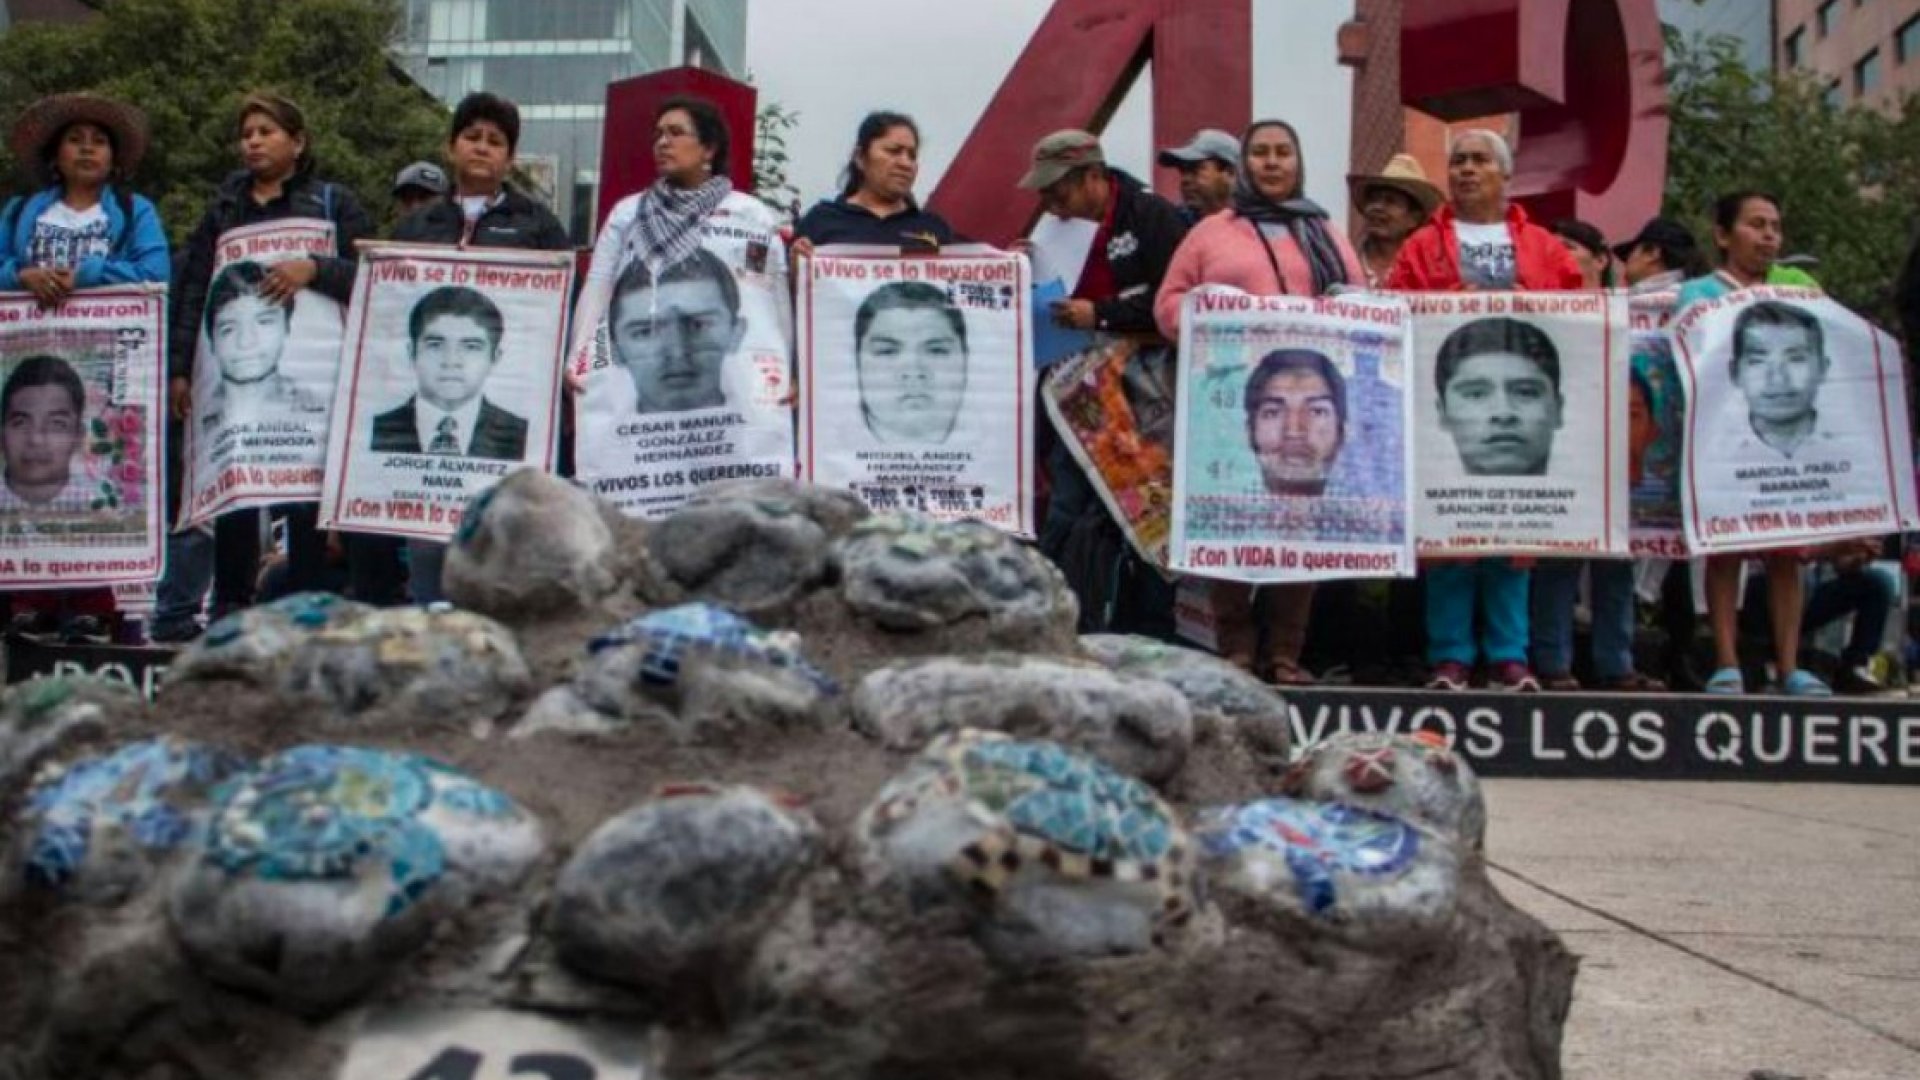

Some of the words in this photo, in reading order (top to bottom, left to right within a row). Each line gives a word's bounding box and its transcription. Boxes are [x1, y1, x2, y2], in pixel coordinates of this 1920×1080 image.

[425, 266, 446, 281] se
[451, 265, 470, 283] lo
[475, 268, 562, 290] llevaron!
[815, 260, 867, 280] ¡Vivo
[872, 263, 894, 279] se
[900, 261, 919, 279] lo
[925, 261, 1012, 281] llevaron!
[1194, 292, 1250, 314] ¡Vivo
[1312, 295, 1402, 325] llevaron!
[1459, 299, 1481, 314] se
[1487, 295, 1505, 314] lo
[1511, 294, 1599, 315] llevaron!
[678, 412, 748, 430] MANUEL
[240, 436, 315, 447] MENDOZA
[248, 465, 264, 483] lo
[383, 457, 435, 470] JORGE
[1803, 460, 1852, 475] PABLO
[422, 474, 465, 488] NAVA
[654, 470, 685, 488] LOS
[688, 463, 782, 486] QUEREMOS!
[1487, 487, 1577, 500] GETSEMANY
[347, 499, 381, 519] ¡Con
[386, 499, 424, 522] VIDA
[429, 503, 445, 522] lo
[1744, 511, 1784, 532] VIDA
[1786, 510, 1802, 527] lo
[1807, 504, 1888, 529] queremos!
[23, 559, 42, 574] lo
[48, 556, 156, 576] queremos!
[1190, 545, 1227, 568] ¡Con
[1234, 546, 1276, 568] VIDA
[1281, 547, 1297, 568] lo
[1302, 551, 1398, 571] queremos!
[1531, 710, 1666, 763] LOS
